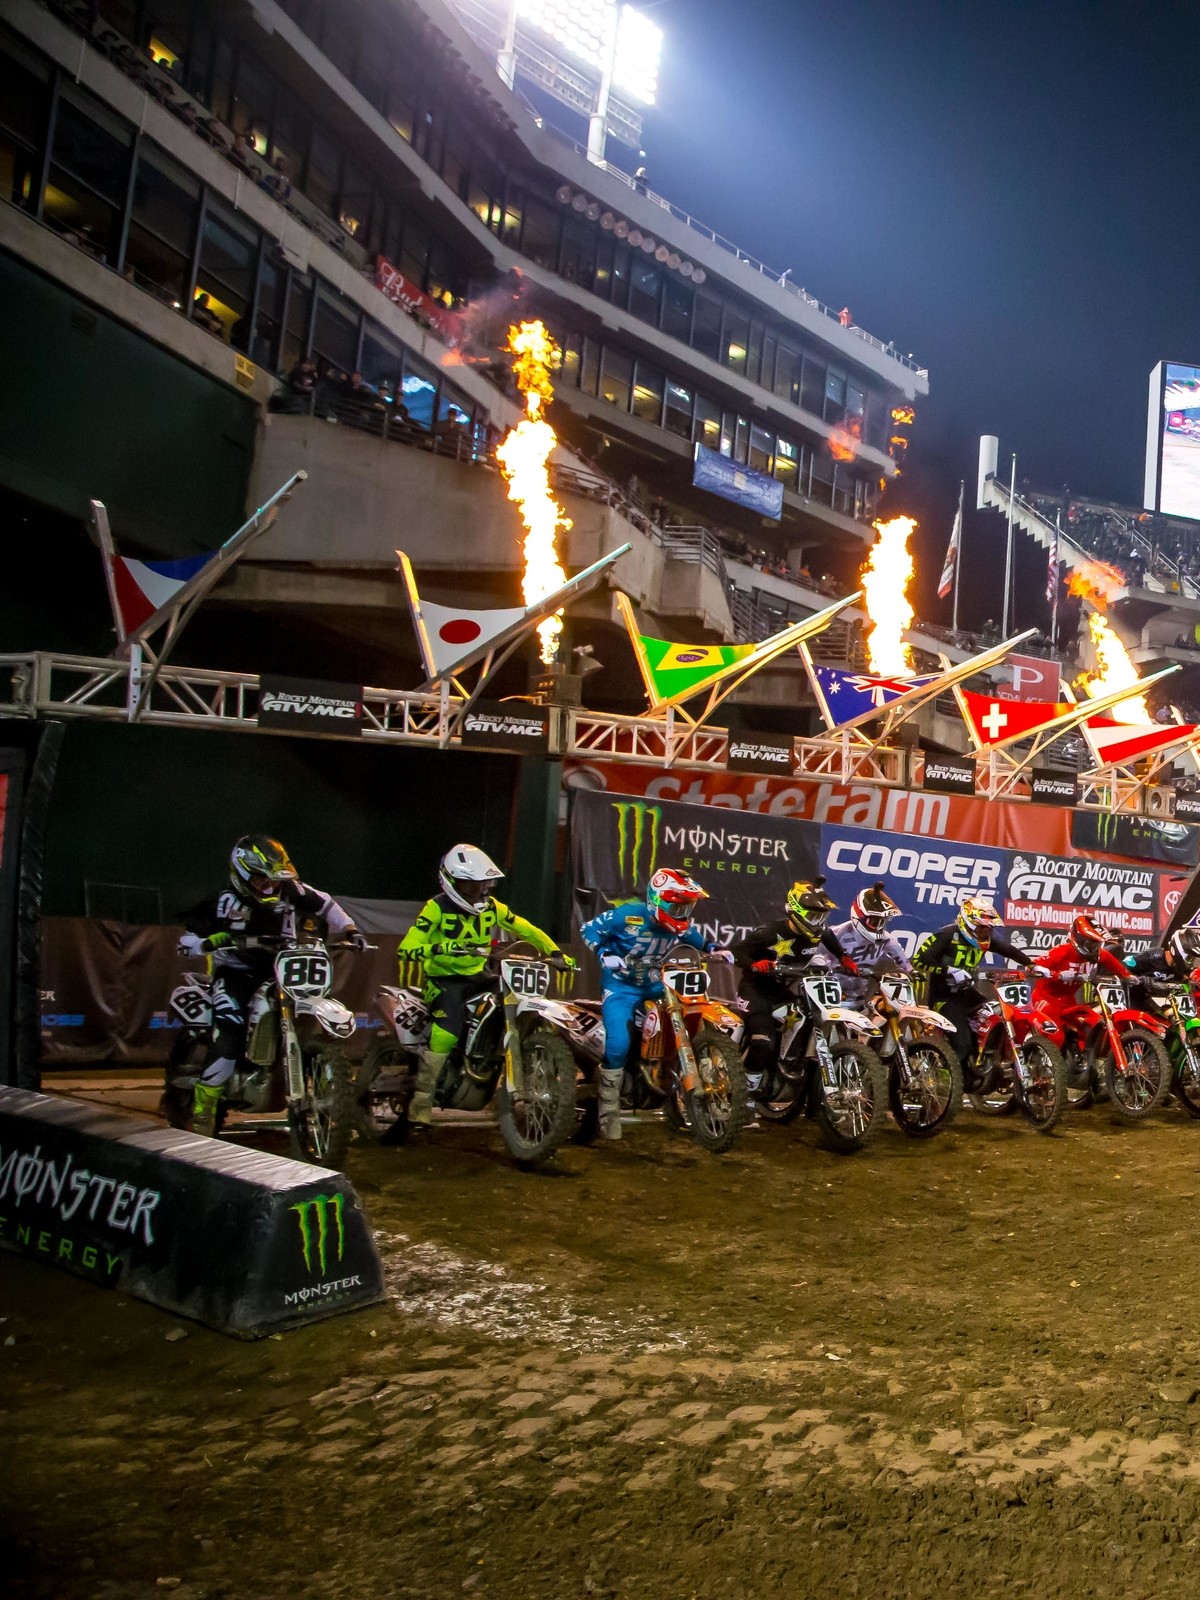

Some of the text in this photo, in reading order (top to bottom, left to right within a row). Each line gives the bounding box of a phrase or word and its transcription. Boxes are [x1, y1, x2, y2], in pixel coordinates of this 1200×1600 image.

[1004, 664, 1044, 691] P
[278, 692, 356, 708] ROCKY MOUNTAIN
[478, 713, 543, 727] ROCKY MOUNTAIN
[664, 824, 791, 862] MONSTER
[683, 857, 772, 876] ENERGY
[826, 839, 1000, 889] COOPER
[1033, 855, 1153, 887] ROCKY MOUNTAIN
[914, 881, 997, 907] TIRES
[1030, 930, 1069, 949] ROCK
[284, 958, 327, 987] 86
[511, 968, 547, 994] 606
[670, 971, 706, 995] 19
[172, 990, 207, 1020] 86
[813, 982, 840, 1005] 15
[1005, 986, 1028, 1005] 99
[575, 1012, 599, 1034] 19
[284, 1274, 362, 1306] MONSTER
